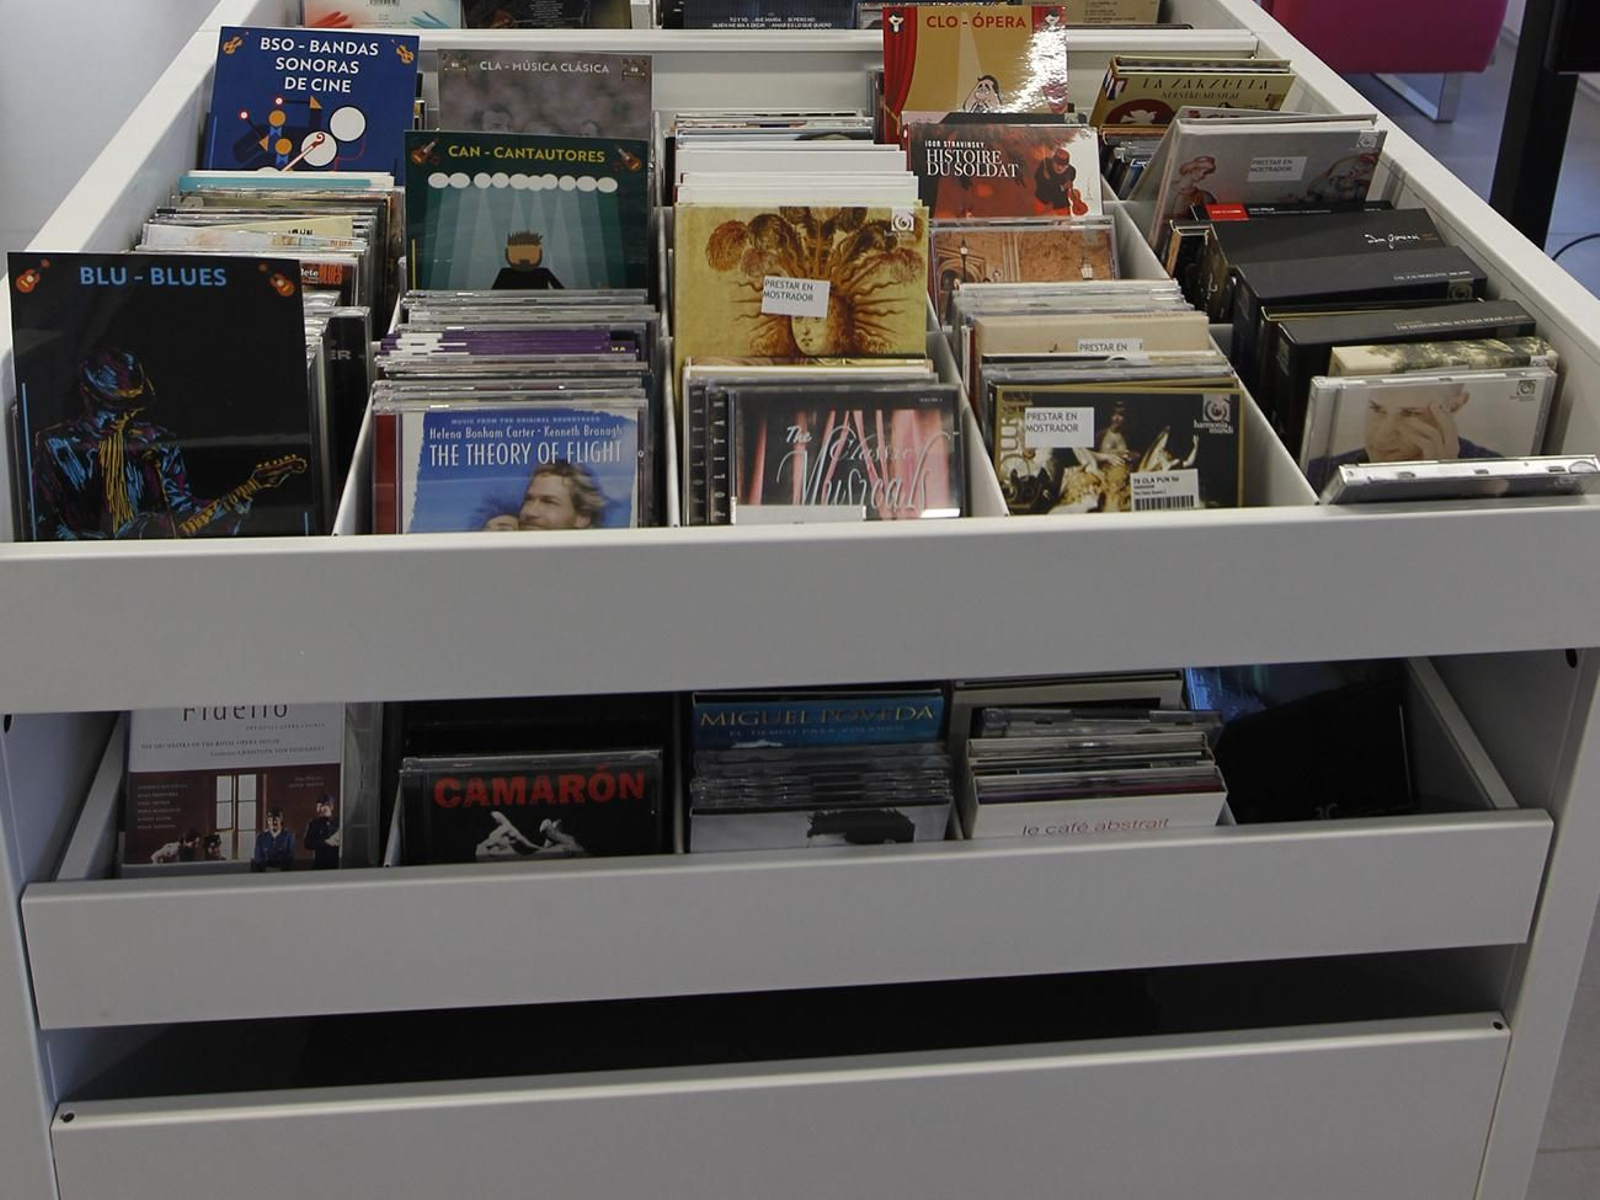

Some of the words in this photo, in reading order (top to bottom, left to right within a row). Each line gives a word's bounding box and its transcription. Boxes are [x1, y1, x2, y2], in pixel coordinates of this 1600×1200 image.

[926, 15, 958, 28] CLO
[971, 12, 1027, 28] ÓPERA
[260, 37, 294, 51] BSO
[309, 39, 379, 56] BANDAS
[275, 57, 359, 74] SONORAS
[479, 61, 503, 71] CLA
[512, 60, 558, 72] MÚSICA
[560, 61, 610, 74] CLÁSICA
[284, 76, 307, 91] DE
[310, 78, 352, 93] CINE
[924, 140, 941, 148] IGOR
[943, 140, 985, 149] STRAVINSKY
[448, 145, 480, 158] CAN
[493, 146, 606, 163] CANTAUTORES
[926, 148, 1003, 164] HISTOIRE
[927, 161, 951, 177] DU
[954, 162, 1020, 178] SOLDAT
[80, 266, 126, 285] BLU
[151, 267, 227, 287] BLUES
[764, 278, 800, 290] PRESTAR
[802, 283, 813, 291] EN
[763, 290, 814, 302] MOSTRADOR
[1079, 343, 1115, 351] PRESTAR
[1116, 343, 1128, 351] EN
[1026, 412, 1064, 421] PRESTAR
[1066, 412, 1078, 420] EN
[430, 428, 462, 440] Helena
[465, 427, 503, 439] Bonham
[506, 426, 535, 438] Carter
[544, 425, 580, 437] Kenneth
[584, 425, 622, 439] Branagh
[785, 425, 812, 444] The
[1025, 423, 1079, 433] MOSTRADOR
[430, 444, 459, 466] THE
[467, 442, 531, 466] THEORY
[538, 441, 560, 465] OF
[567, 440, 621, 463] FLIGHT
[777, 431, 950, 510] Musicals
[700, 708, 808, 727] MIGUEL
[433, 763, 645, 808] CAMARÓN
[1045, 821, 1088, 835] café
[1094, 817, 1170, 830] abstrait
